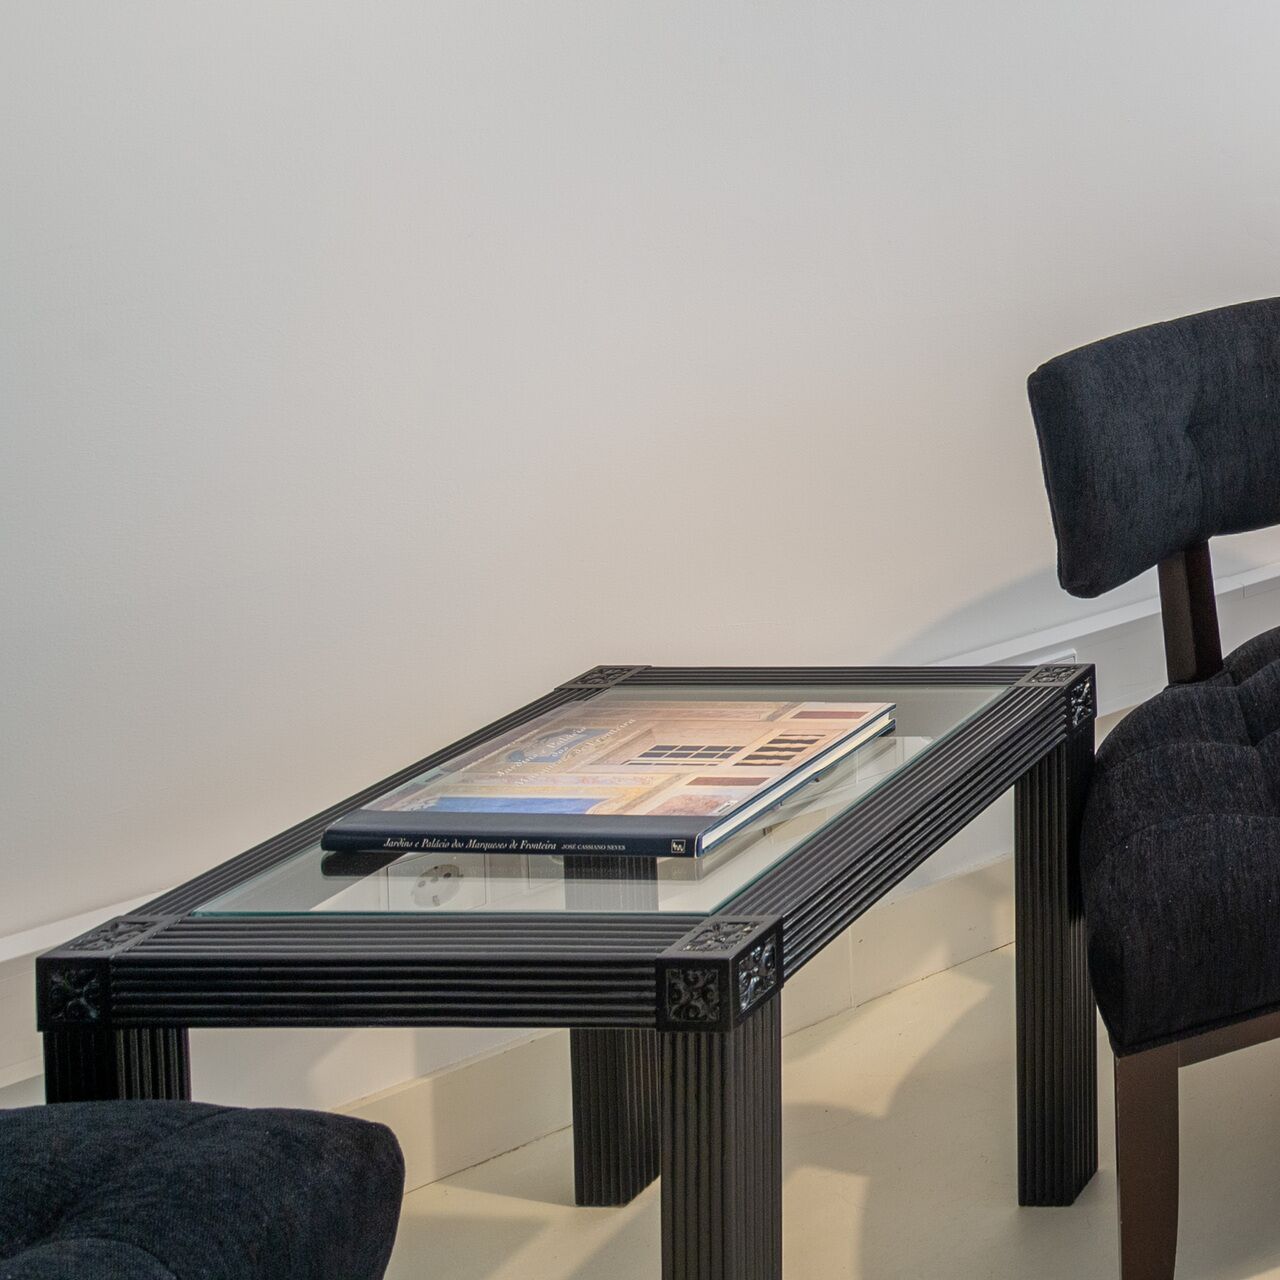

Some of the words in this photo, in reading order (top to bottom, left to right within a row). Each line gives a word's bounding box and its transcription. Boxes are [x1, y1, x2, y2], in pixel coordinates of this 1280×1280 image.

[383, 837, 414, 848] Jardins
[509, 839, 518, 849] de
[520, 840, 557, 851] Fronteira
